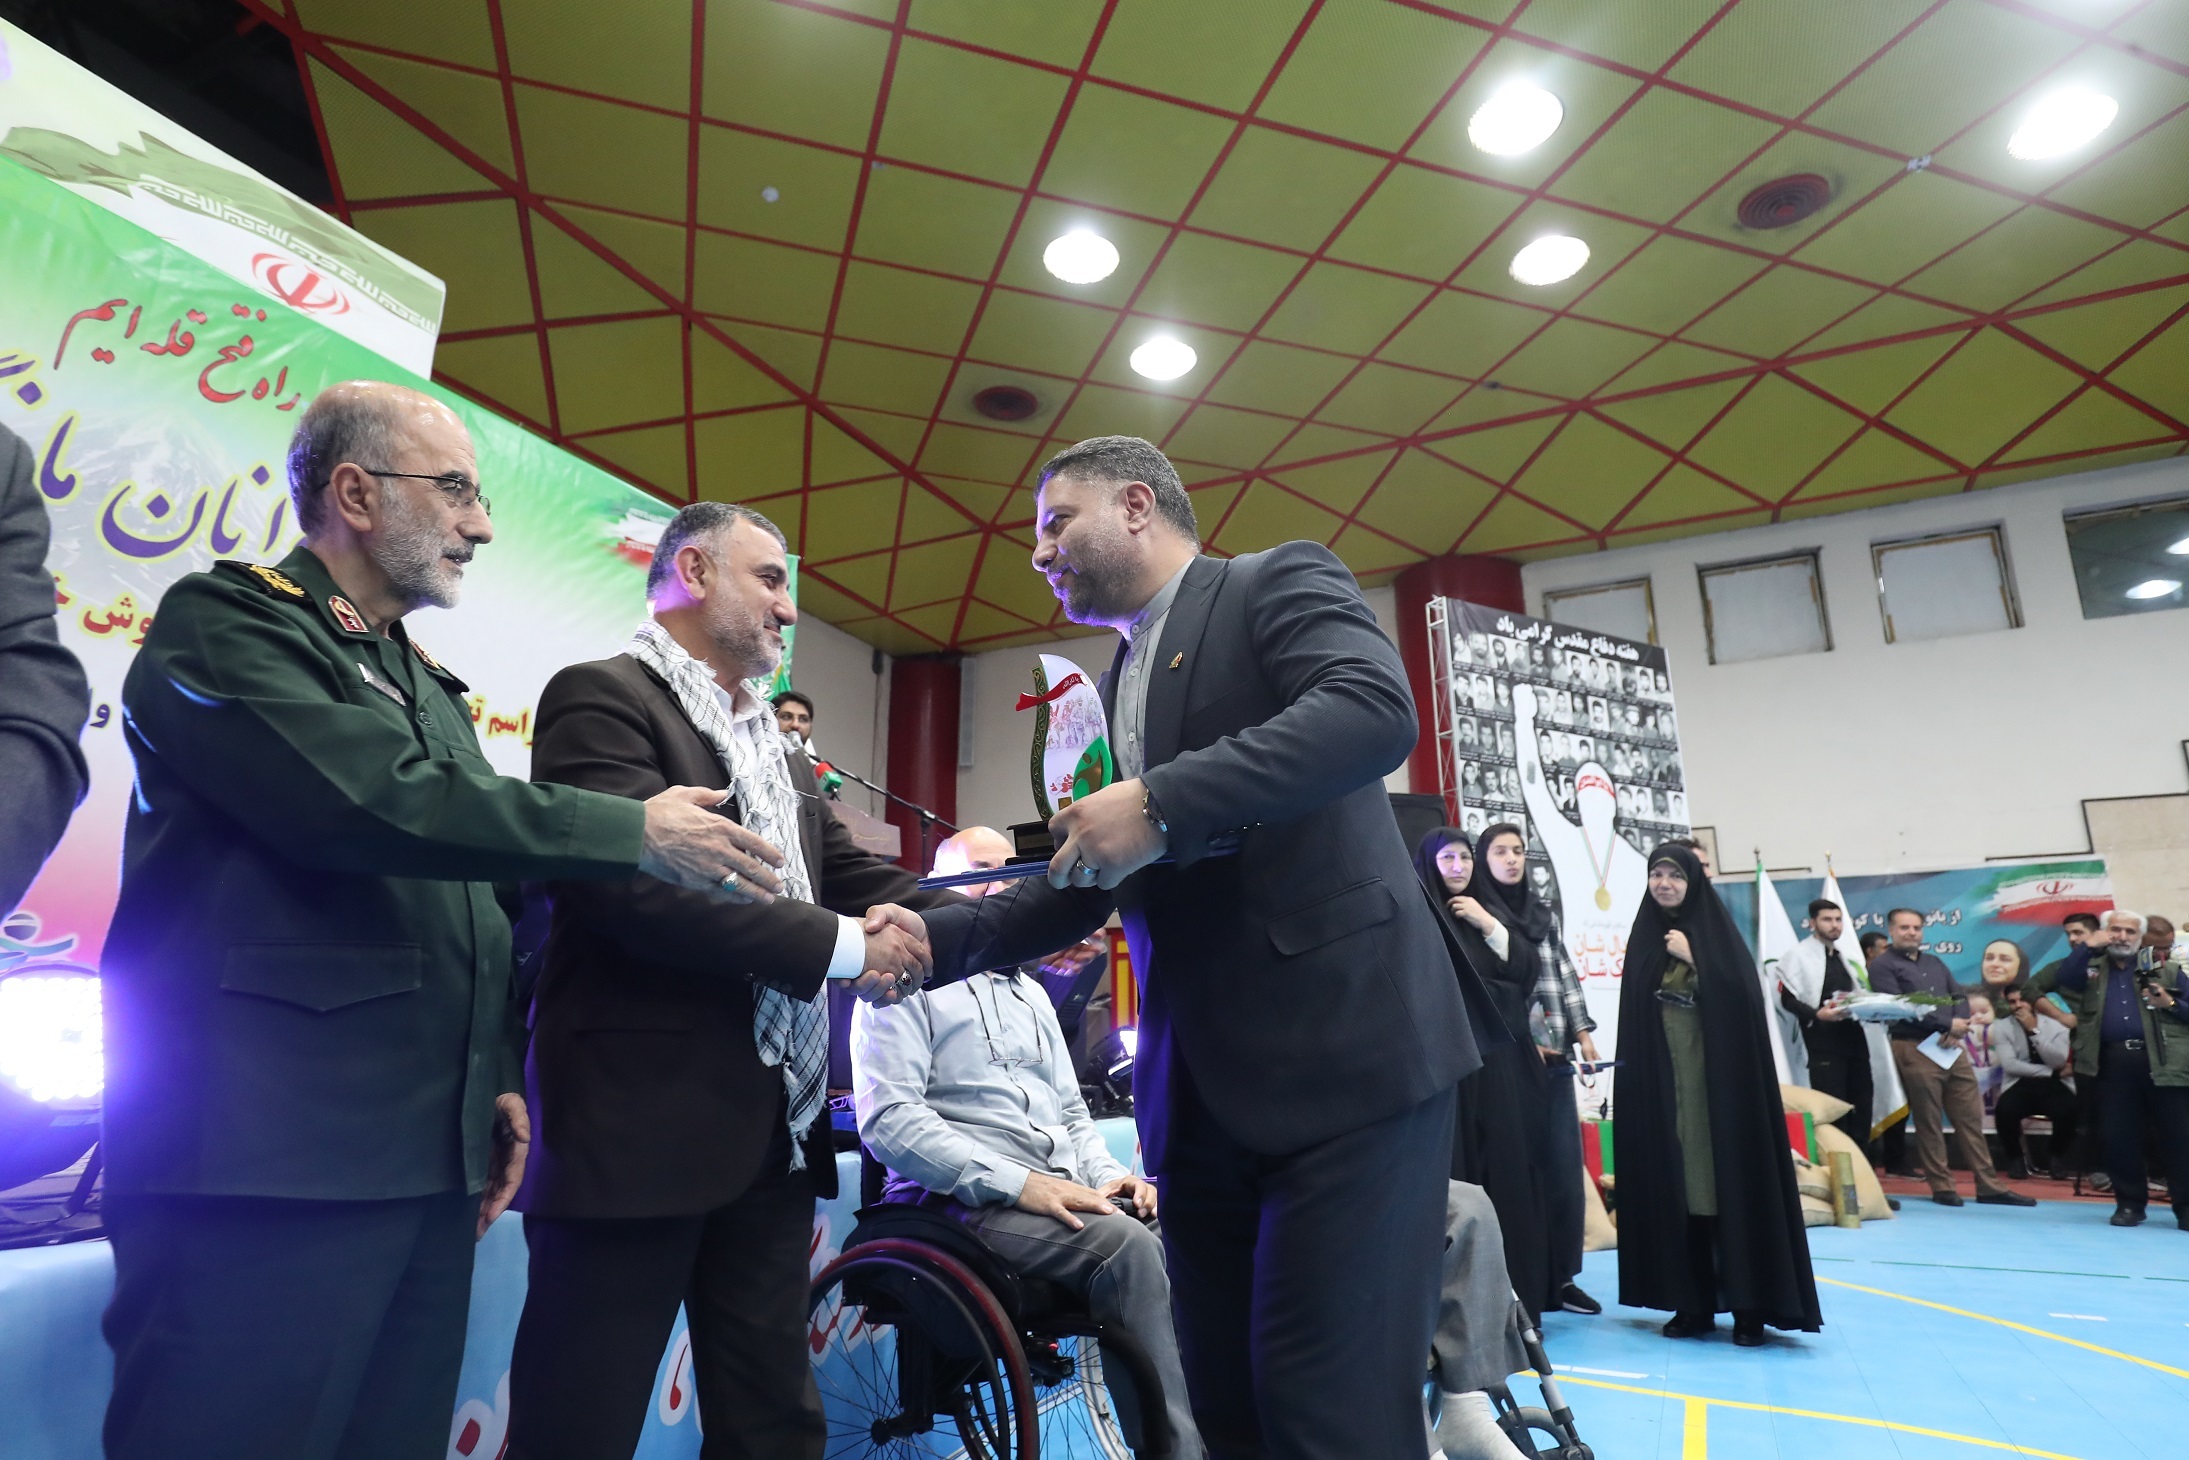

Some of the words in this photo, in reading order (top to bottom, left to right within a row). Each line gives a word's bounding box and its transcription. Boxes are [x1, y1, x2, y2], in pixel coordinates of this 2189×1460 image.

[53, 298, 142, 370] ایم
[140, 308, 207, 357] قله
[198, 303, 267, 403] فتح
[1496, 615, 1515, 638] باد
[1515, 621, 1553, 645] گرامی
[1553, 631, 1590, 650] مقدس
[1589, 636, 1616, 657] دفاع
[1616, 642, 1640, 661] هفته
[1951, 908, 1962, 926] از
[1934, 941, 1963, 954] روی
